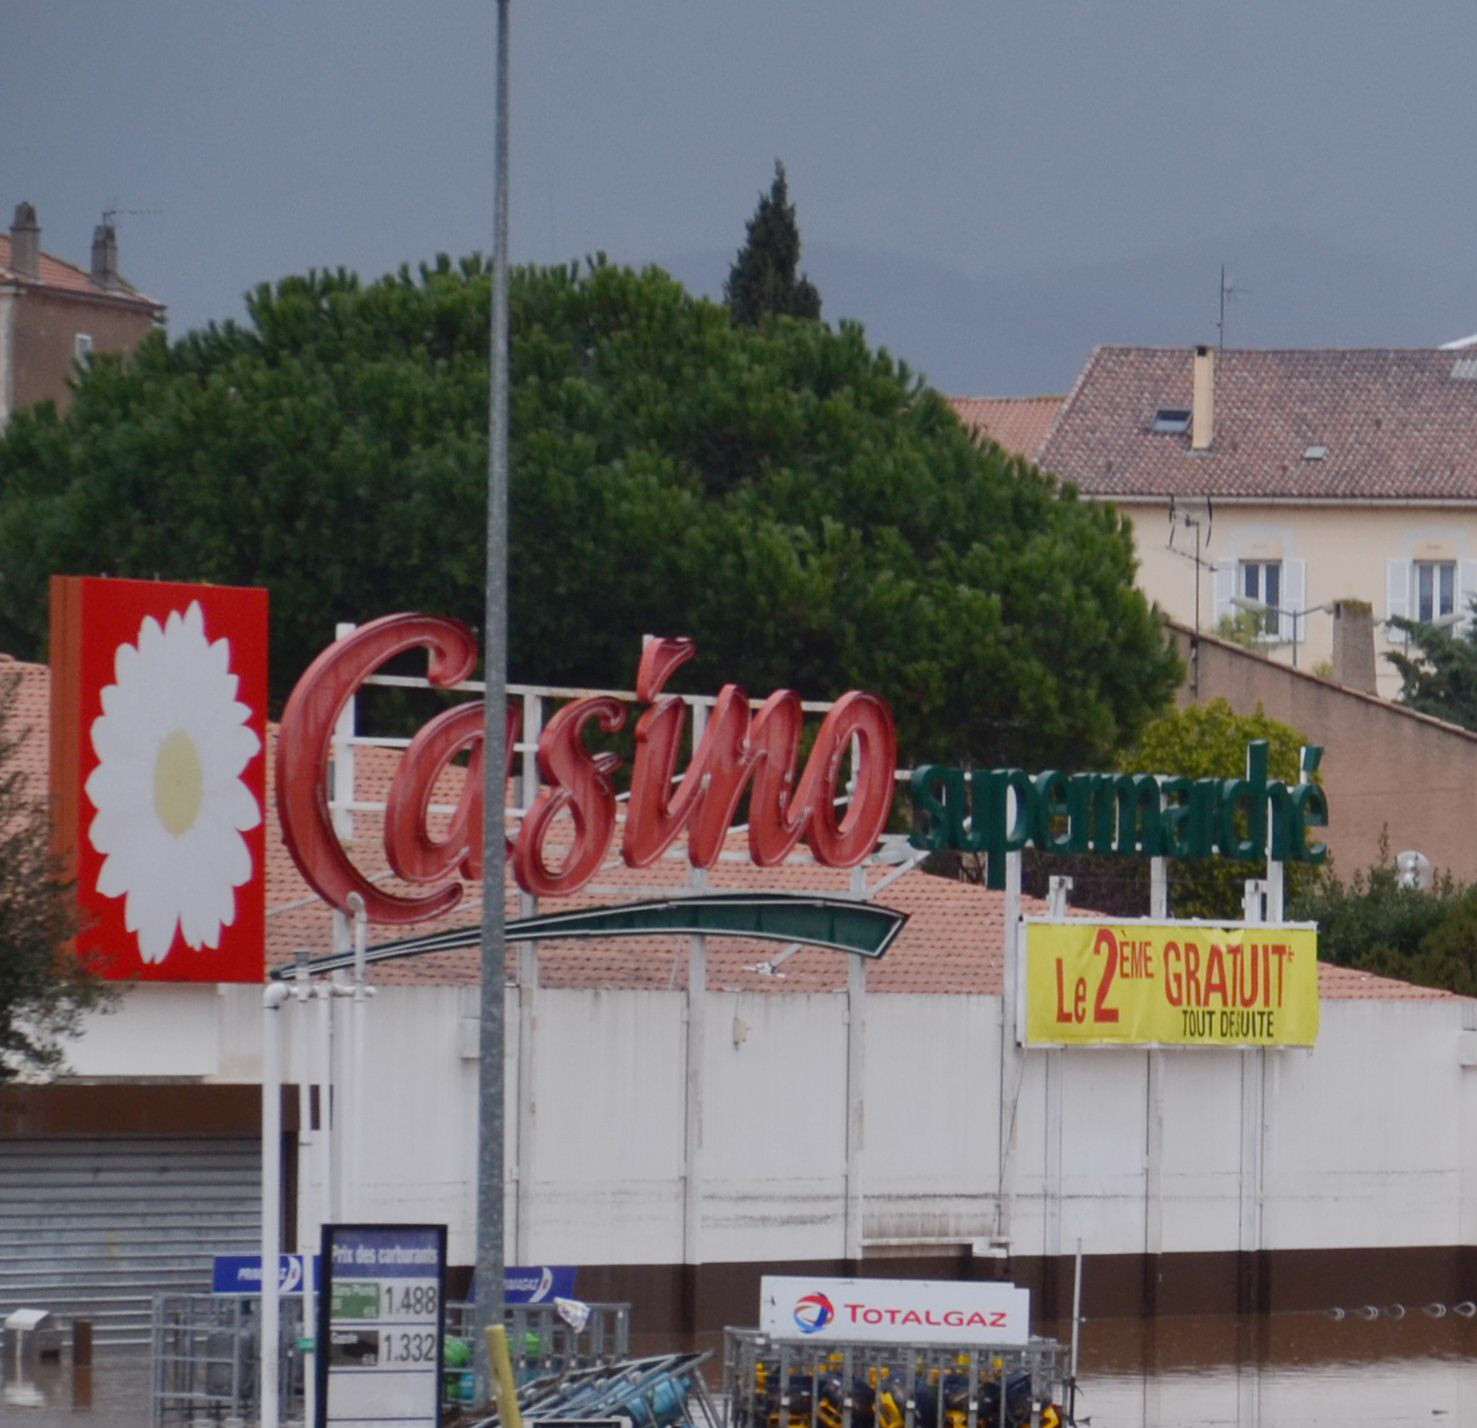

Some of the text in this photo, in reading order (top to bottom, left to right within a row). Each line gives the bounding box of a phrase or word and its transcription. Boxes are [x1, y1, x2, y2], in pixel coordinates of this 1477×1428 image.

[276, 612, 897, 925] Casino
[907, 739, 1329, 890] supermarché
[1055, 957, 1087, 1025] Le
[1182, 1010, 1216, 1038] TOUT
[332, 1244, 438, 1265] Prix des carburants
[385, 1286, 436, 1315] 1.488
[844, 1304, 1007, 1328] TOTALGAZ
[384, 1333, 436, 1362] 1.332
